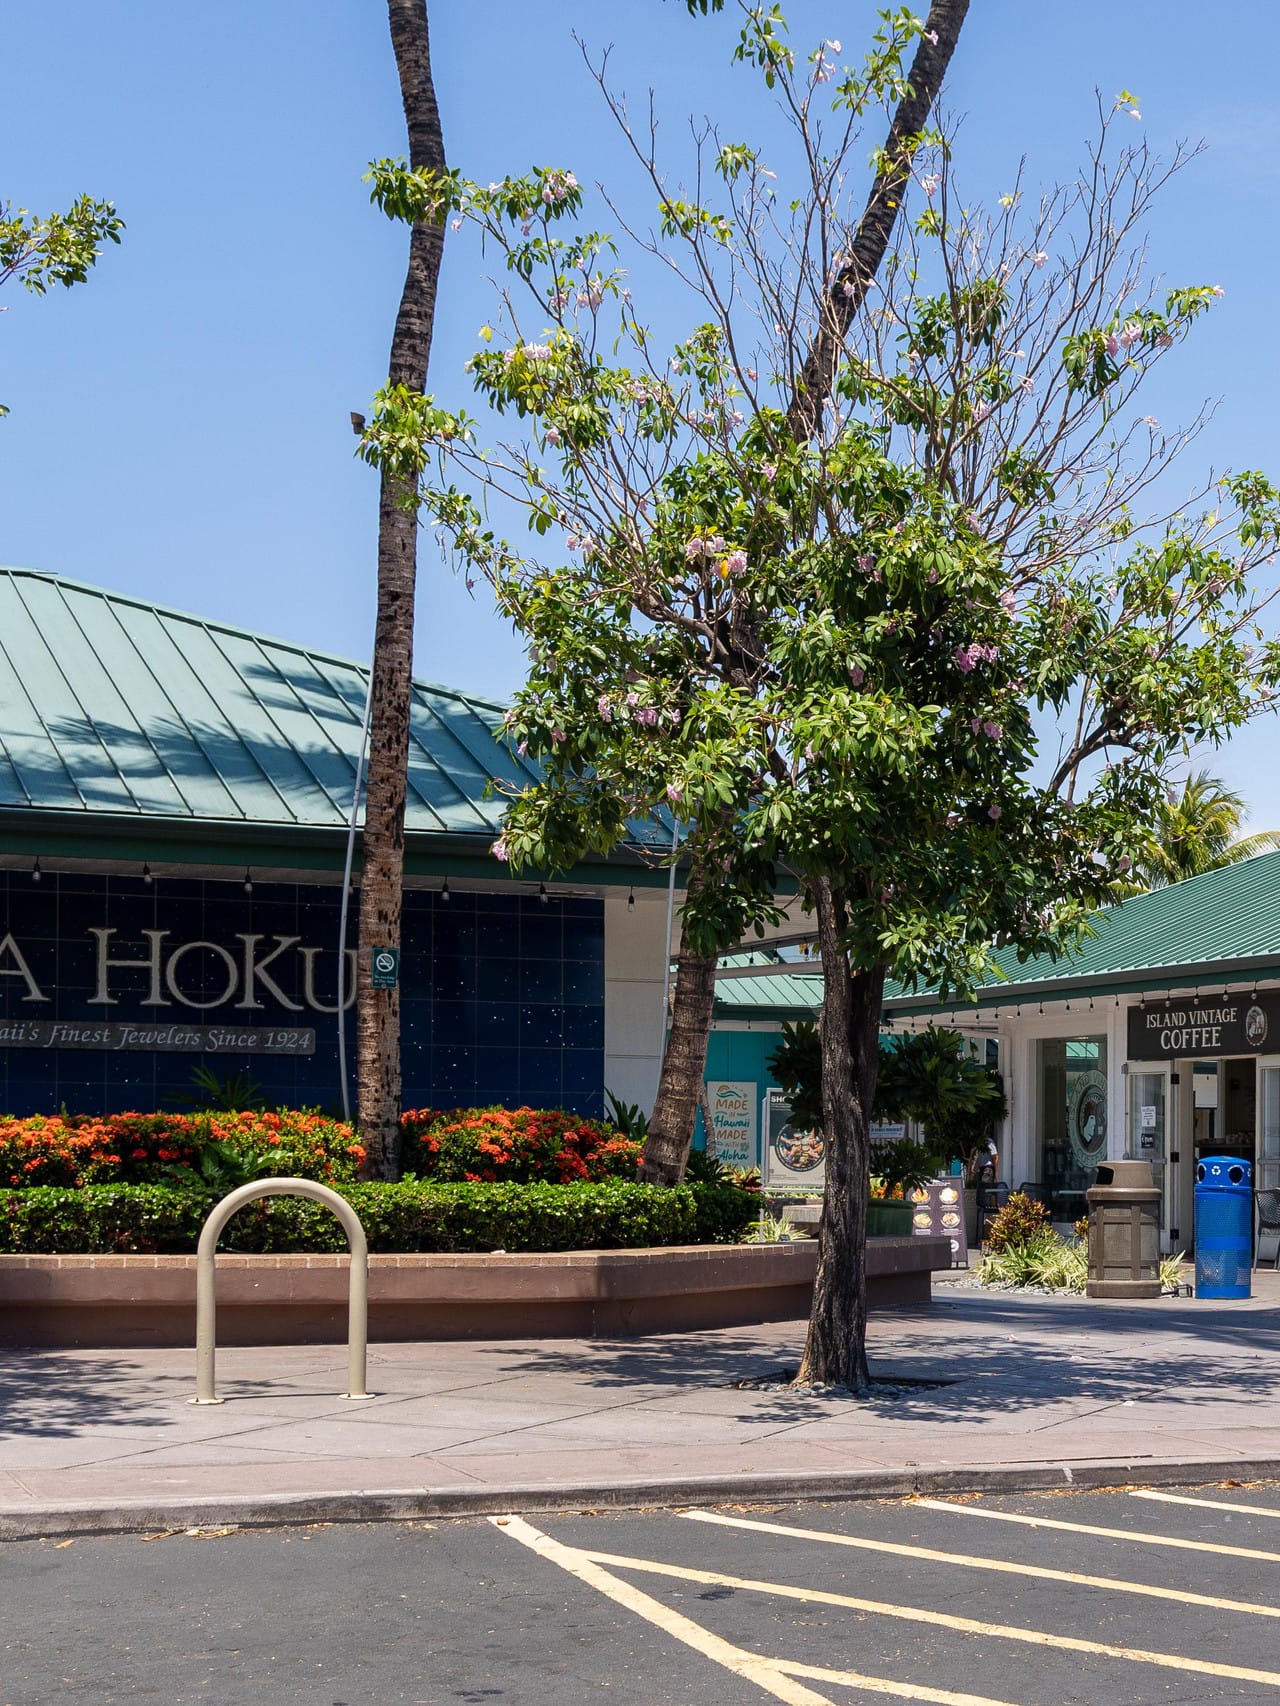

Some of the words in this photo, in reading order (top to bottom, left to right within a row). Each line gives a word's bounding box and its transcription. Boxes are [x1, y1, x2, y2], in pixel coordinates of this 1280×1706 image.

[0, 932, 51, 1002] A
[1146, 1012, 1186, 1028] ISLAND
[1188, 1007, 1238, 1025] VINTAGE
[43, 1025, 111, 1048] Finest
[113, 1026, 201, 1049] Jewelers
[204, 1029, 257, 1052] Since
[264, 1031, 310, 1048] 1924
[1160, 1026, 1222, 1049] COFFEE
[715, 1099, 748, 1111] MADE
[713, 1115, 750, 1128] Hawaii
[716, 1130, 748, 1140] MADE
[715, 1149, 749, 1161] Aloha
